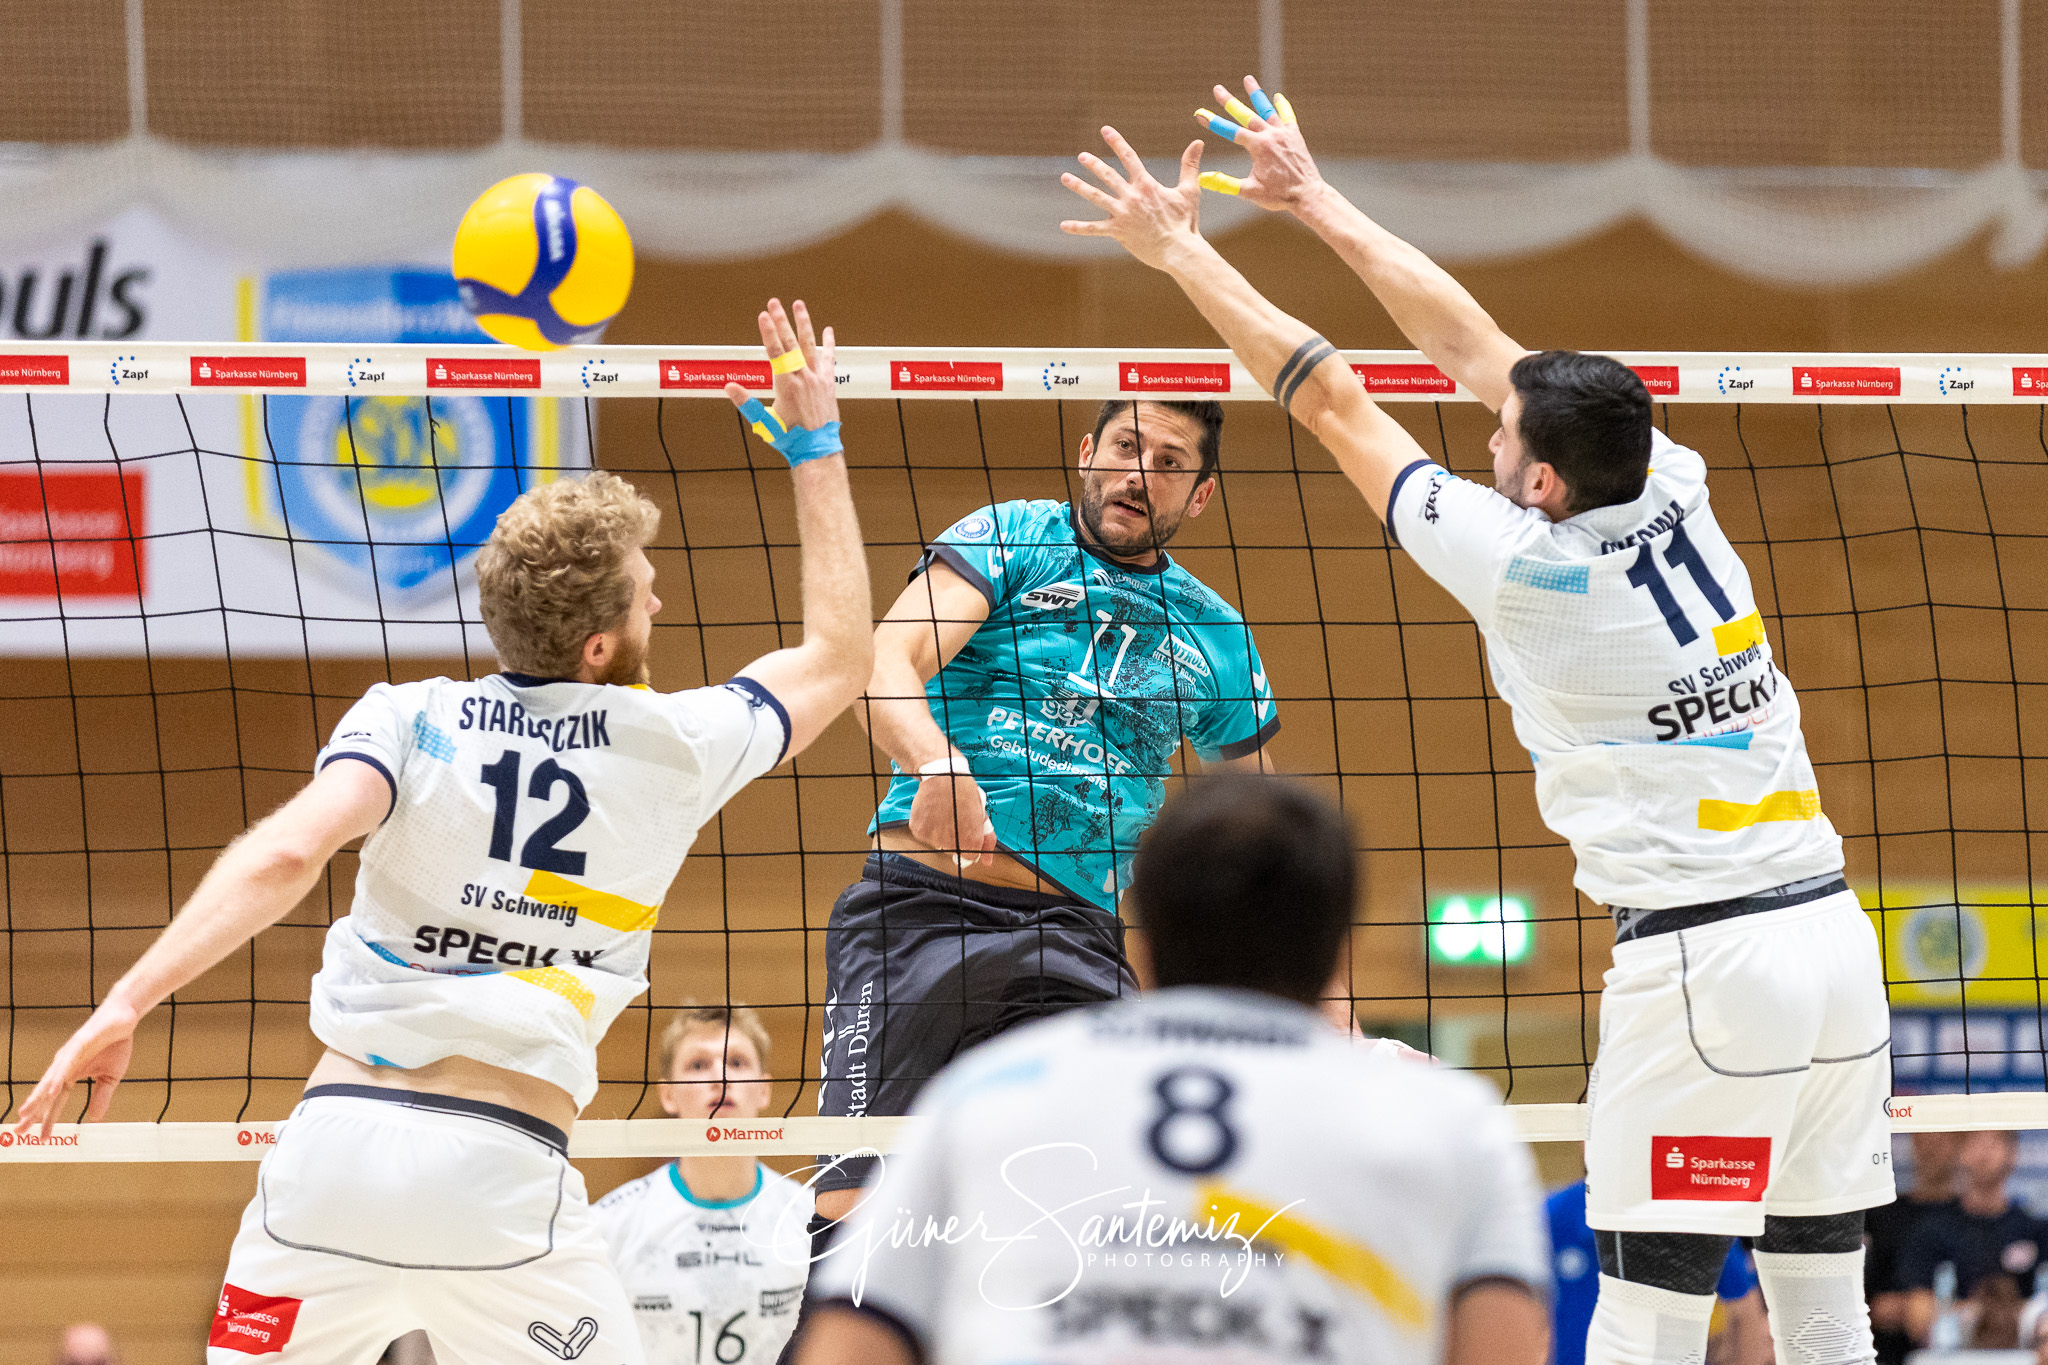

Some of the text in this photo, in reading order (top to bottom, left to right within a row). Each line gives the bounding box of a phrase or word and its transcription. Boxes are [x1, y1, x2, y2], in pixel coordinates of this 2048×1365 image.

[21, 368, 61, 379] Nürnberg
[122, 369, 149, 381] Zapf
[215, 369, 298, 380] Sparkasse Nürnberg
[359, 371, 385, 382] Zapf
[451, 371, 533, 382] Sparkasse Nürnberg
[593, 372, 619, 383] Zapf
[683, 372, 765, 383] Sparkasse Nürnberg
[914, 373, 995, 384] Sparkasse Nürnberg
[834, 374, 850, 385] apf
[1054, 375, 1079, 386] Zapf
[1143, 375, 1223, 385] Sparkasse Nürnberg
[1369, 376, 1448, 387] Sparkasse Nürnberg
[1729, 379, 1754, 390] Zapf
[1816, 379, 1893, 390] Sparkasse Nürnberg
[1950, 380, 1974, 391] Zapf
[1625, 521, 1737, 647] 11
[1668, 638, 1762, 695] SV Schwaig
[1648, 673, 1771, 741] SPECK
[480, 750, 591, 876] 12
[461, 883, 578, 927] SV Schwaig
[413, 924, 560, 968] SPECK
[1147, 1063, 1241, 1179] 8
[723, 1127, 784, 1140] Marmot
[16, 1133, 79, 1146] Mamot
[1690, 1156, 1755, 1174] Sparkasse
[1690, 1172, 1751, 1188] Nürnberg
[688, 1310, 746, 1365] 16
